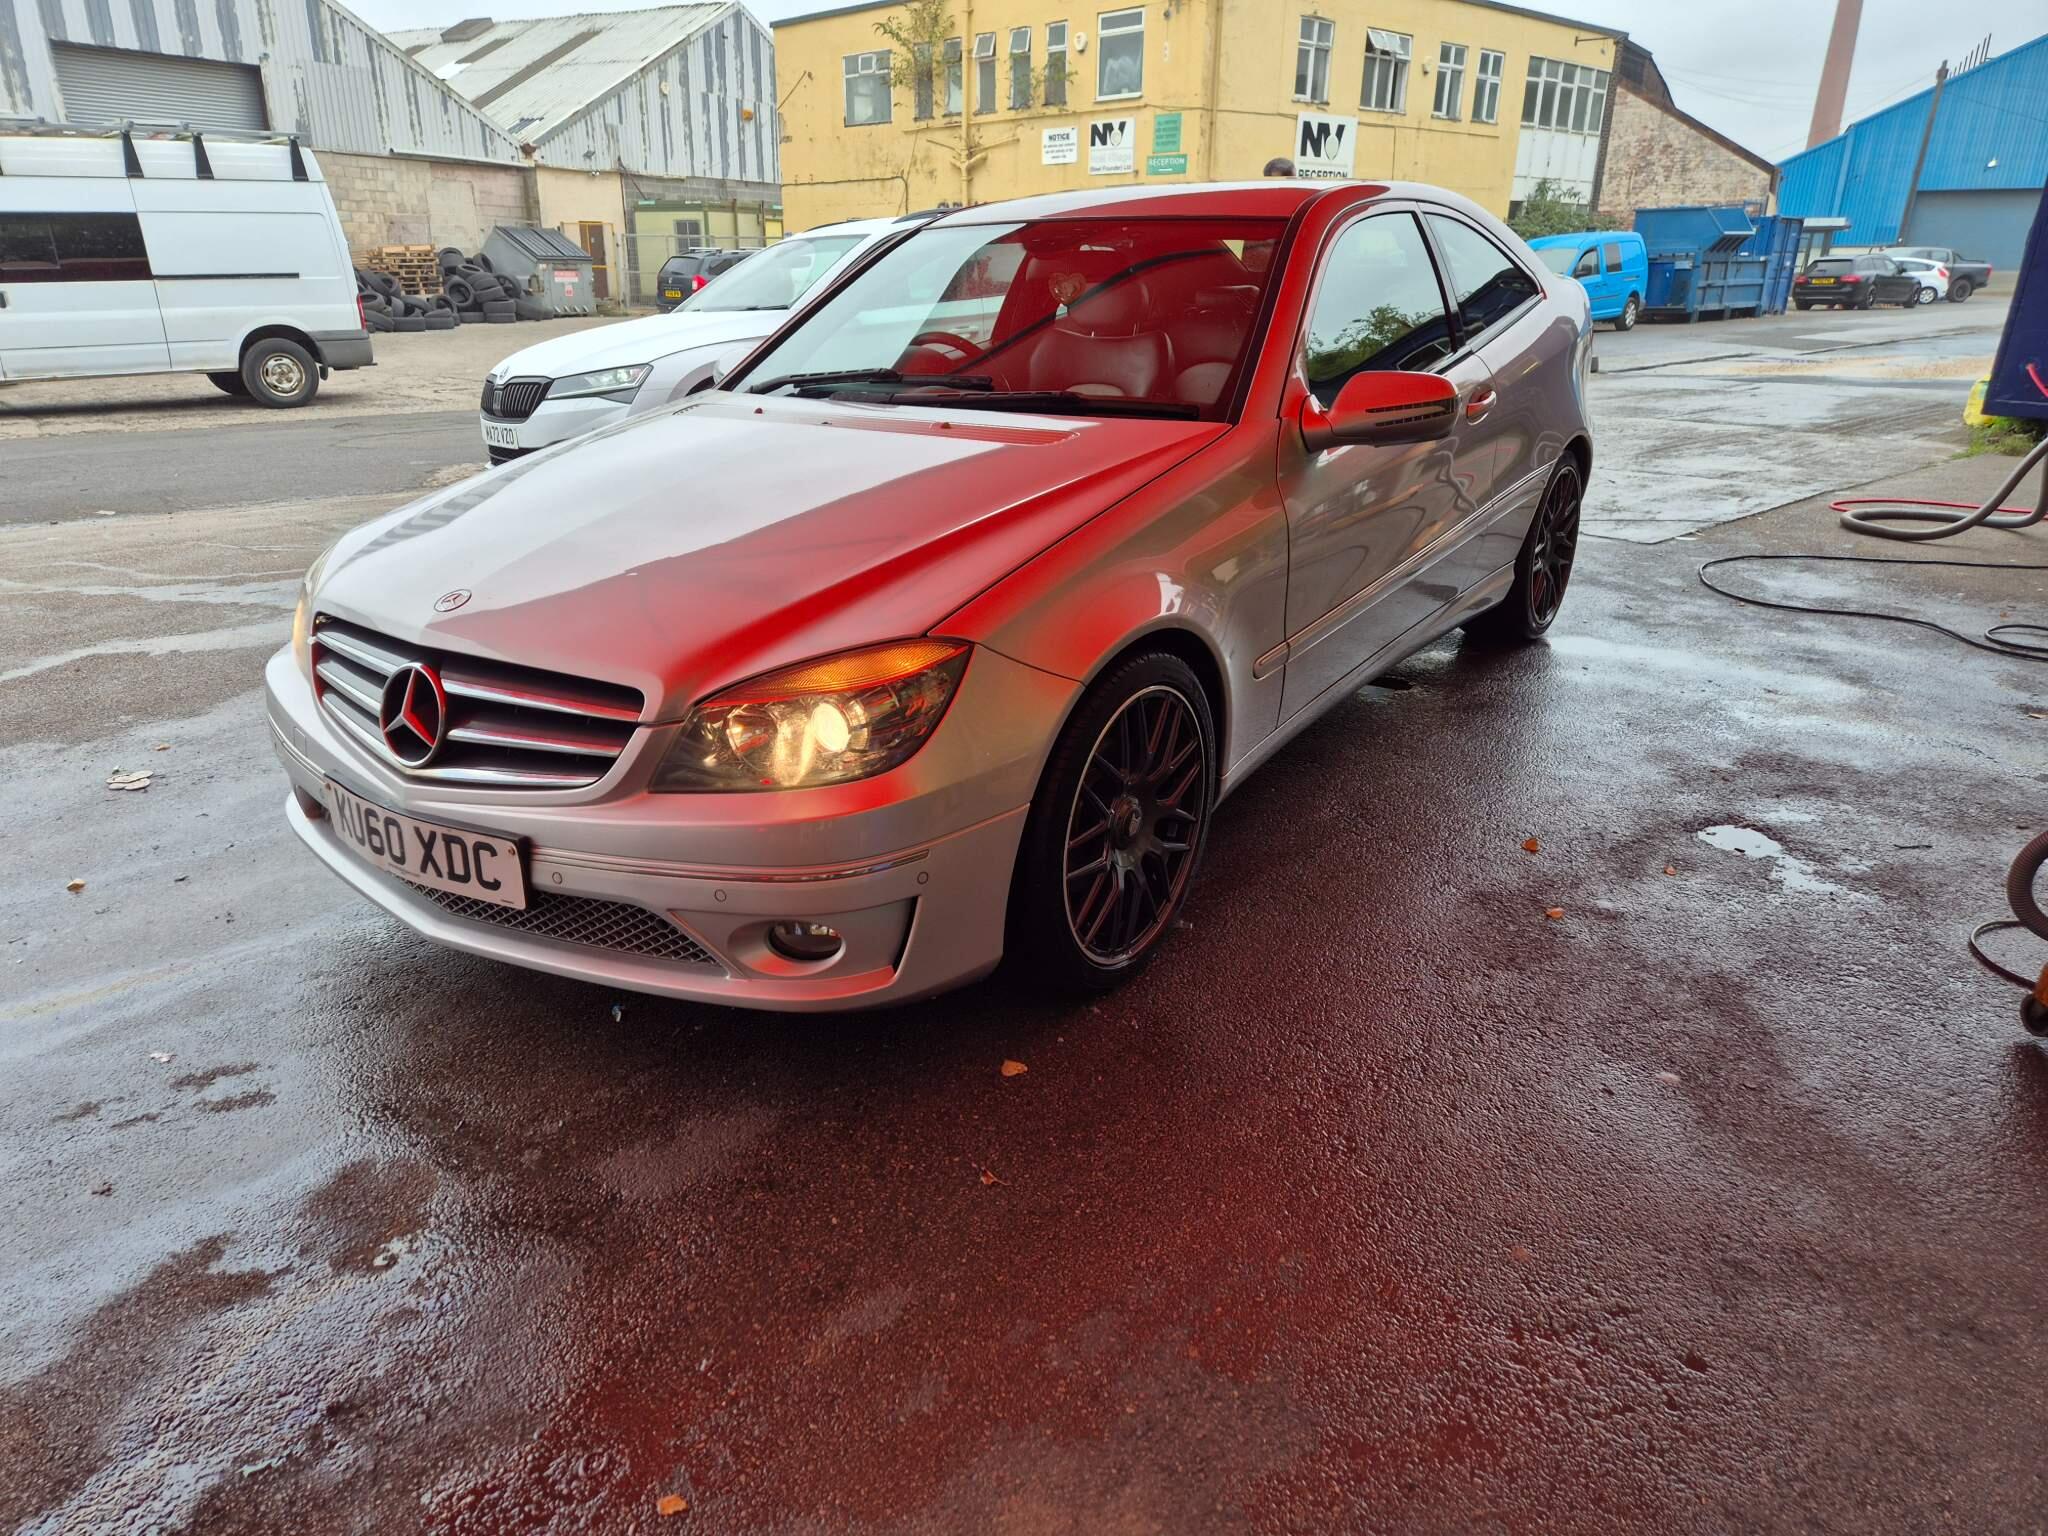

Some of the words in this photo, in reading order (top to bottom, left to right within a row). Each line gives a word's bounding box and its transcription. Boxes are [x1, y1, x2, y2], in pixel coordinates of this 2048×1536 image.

[1048, 132, 1070, 142] NOTICE
[1149, 157, 1185, 167] RECEPTION
[333, 786, 406, 866] KU60
[413, 825, 502, 892] XDC
